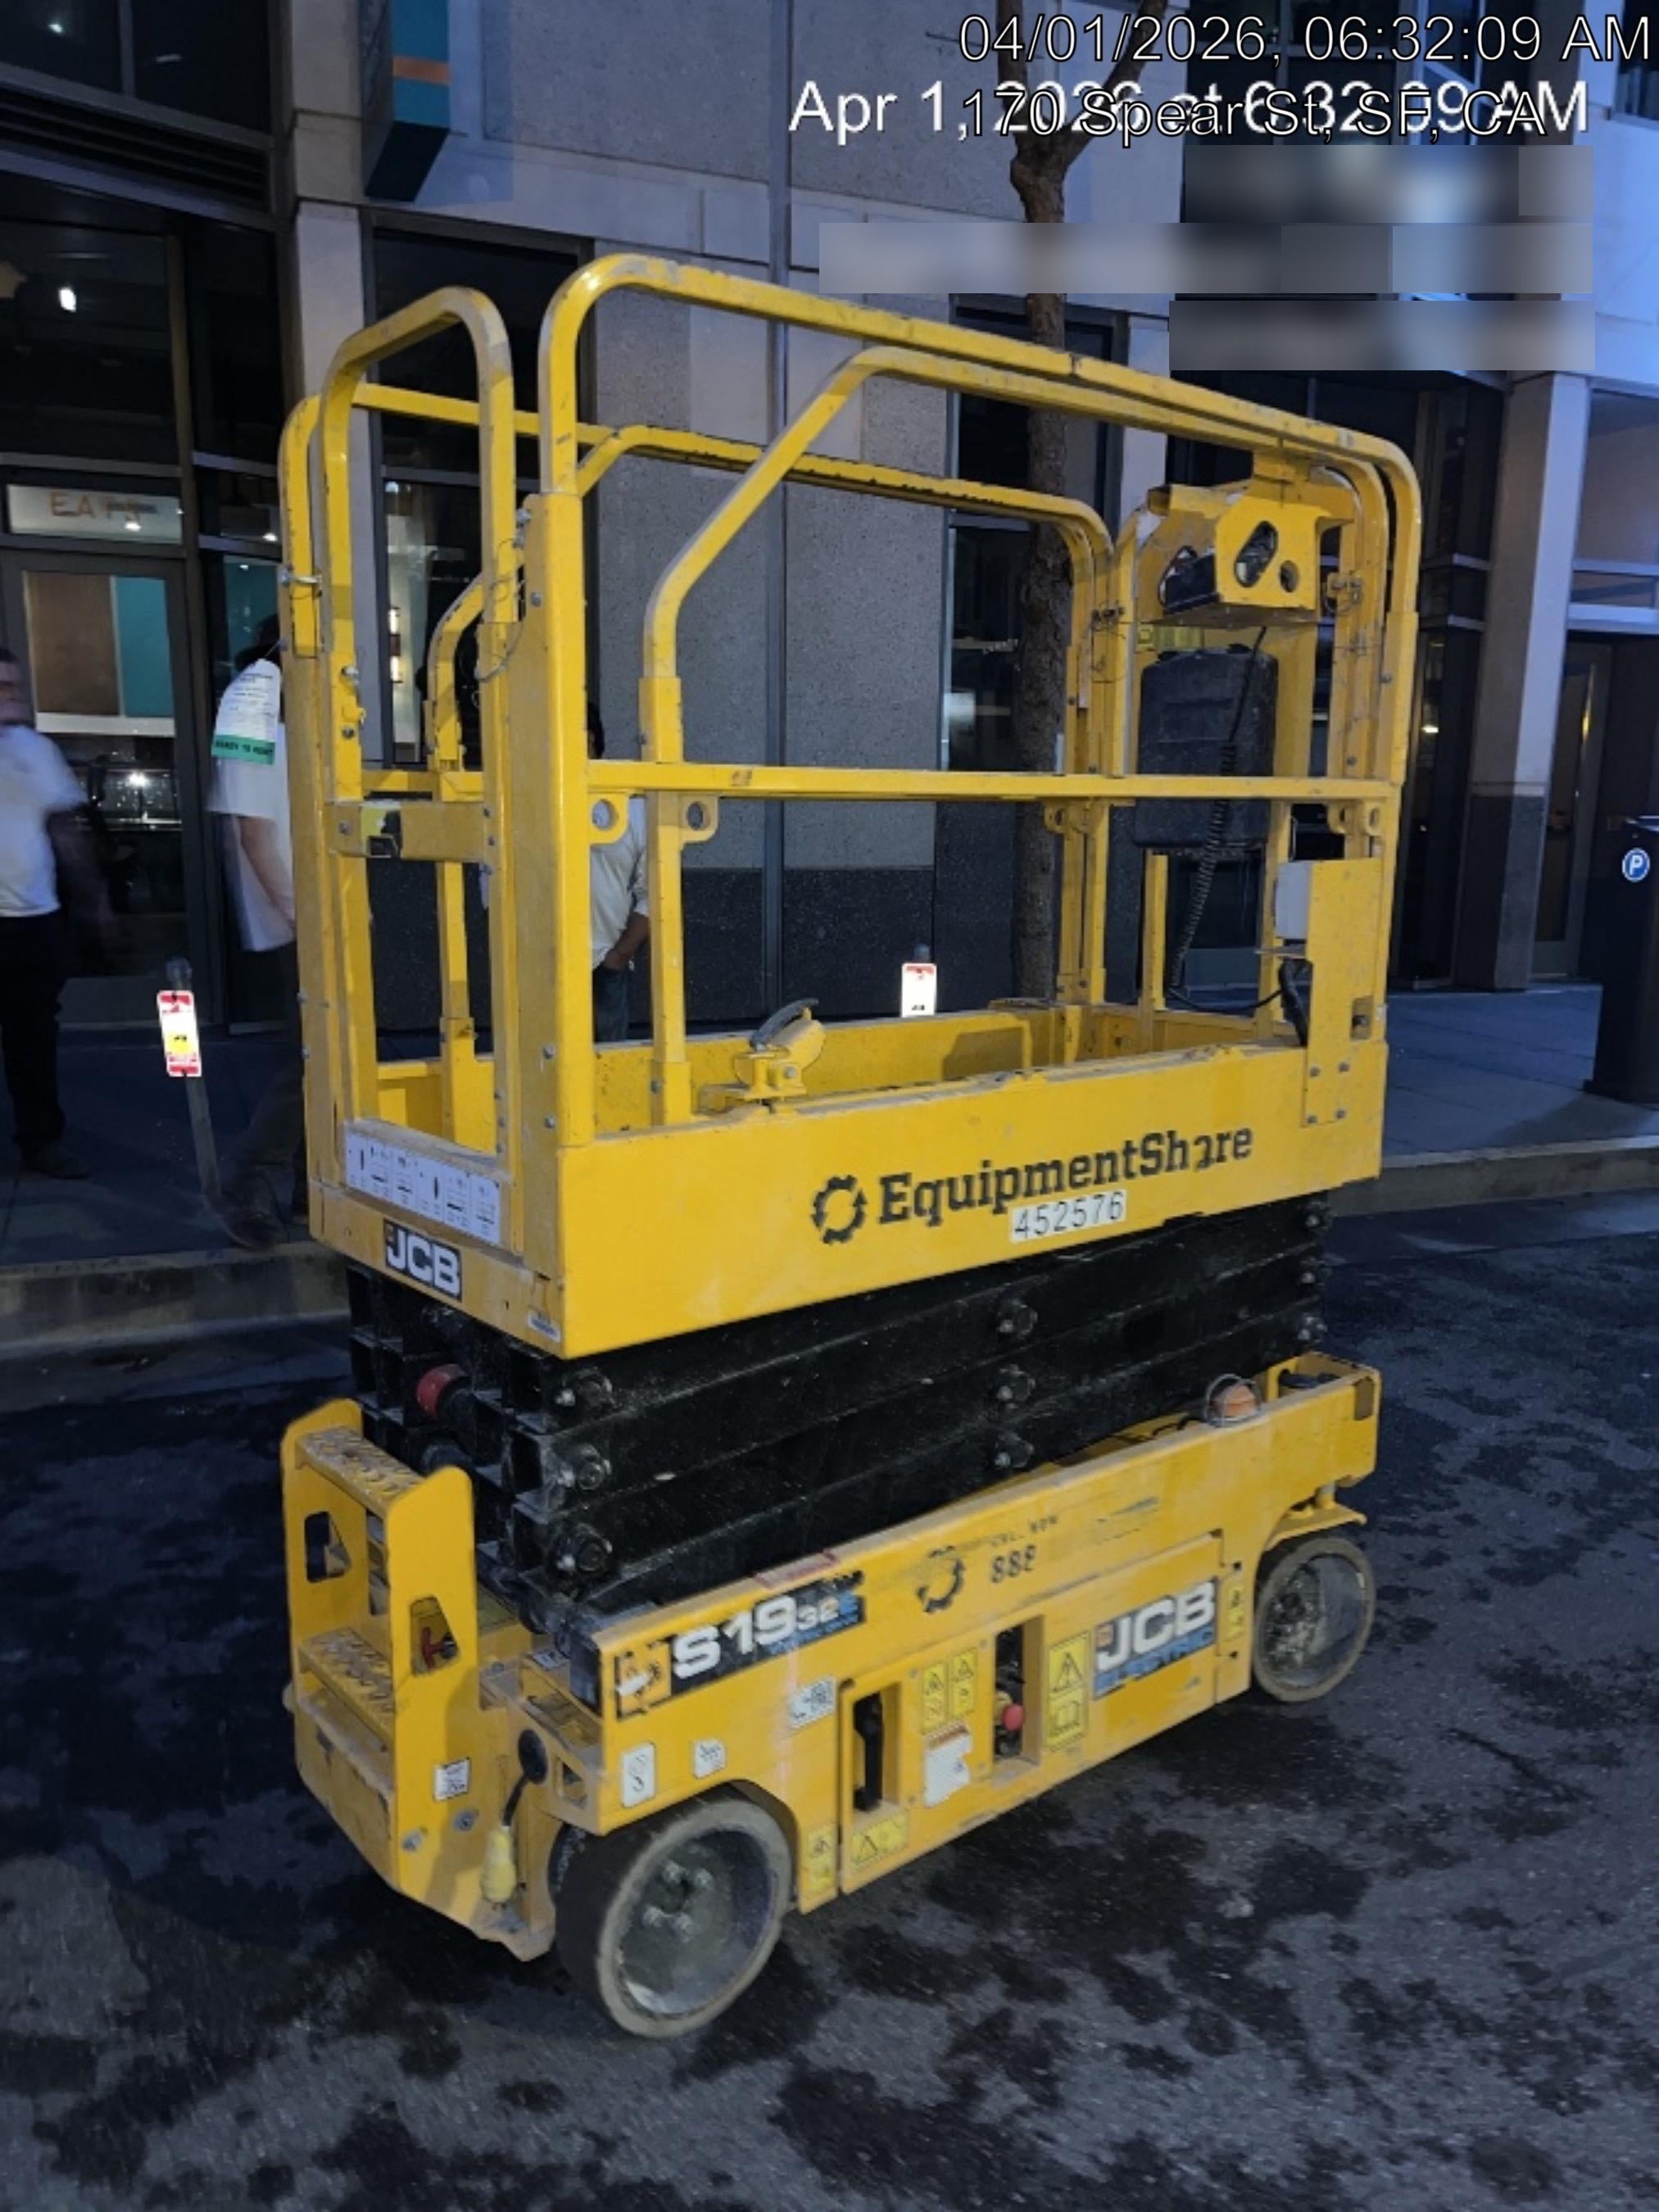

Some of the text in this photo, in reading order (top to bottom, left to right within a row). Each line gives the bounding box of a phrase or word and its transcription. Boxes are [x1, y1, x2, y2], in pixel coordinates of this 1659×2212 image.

[1630, 854, 1643, 875] P
[878, 1126, 1252, 1227] EquipmentShare
[1013, 1191, 1126, 1240] 452576
[387, 1227, 460, 1297] JCB
[1097, 1580, 1214, 1671] JCB
